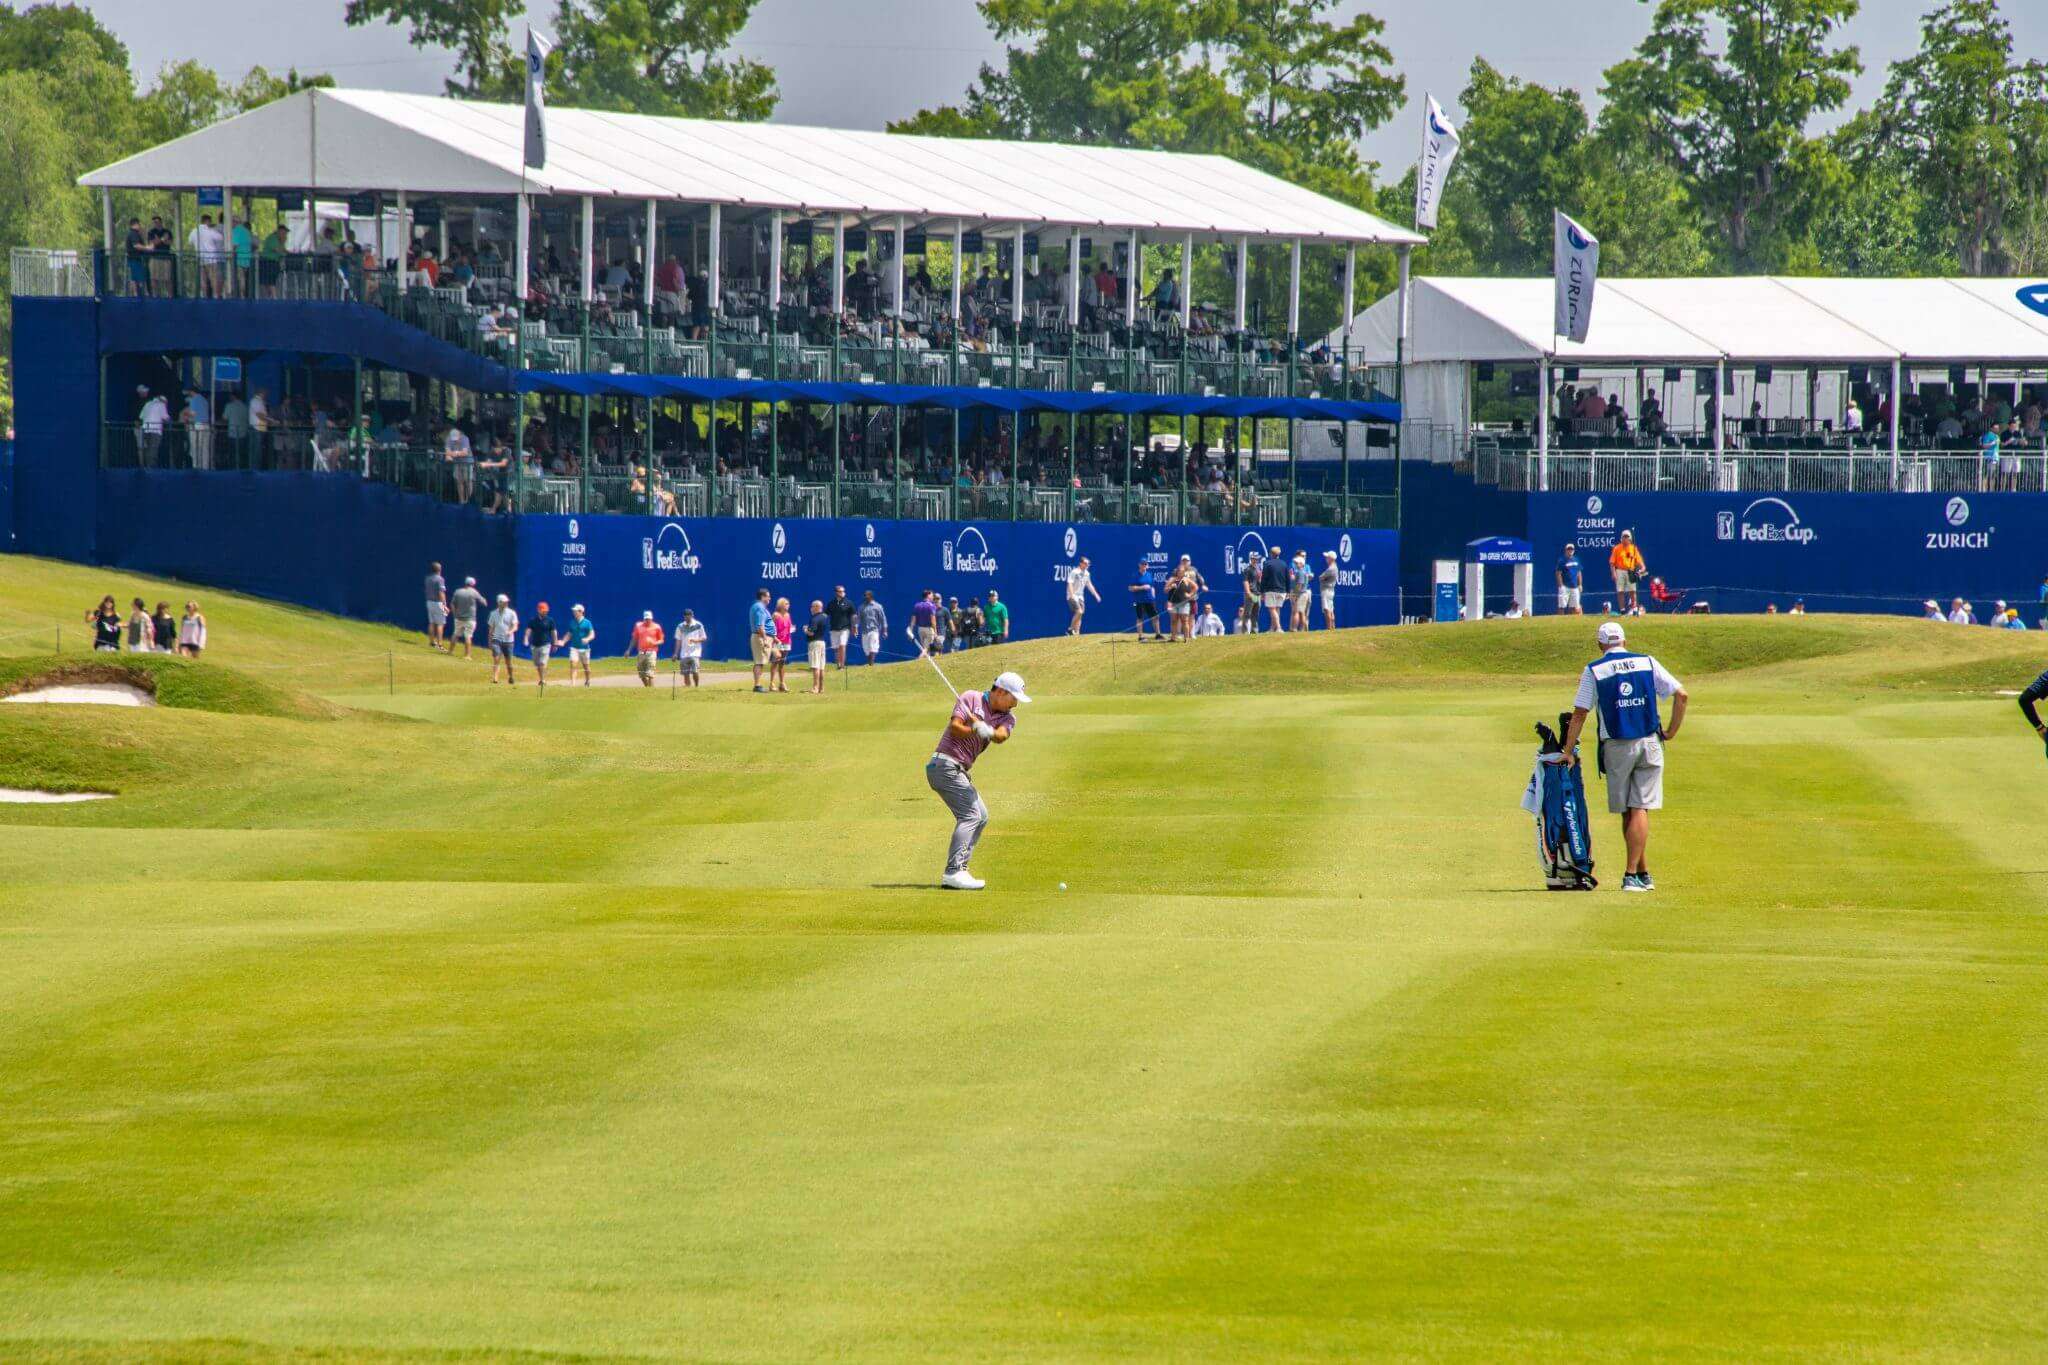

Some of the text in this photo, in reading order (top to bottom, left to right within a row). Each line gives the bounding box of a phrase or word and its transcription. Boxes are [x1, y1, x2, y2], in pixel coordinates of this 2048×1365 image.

[1577, 518, 1615, 529] ZURICH
[1742, 522, 1814, 545] FedExCup
[1577, 537, 1616, 548] CLASSIC
[1926, 532, 1989, 549] ZURICH
[562, 543, 586, 555] ZURICH
[859, 547, 882, 558] ZURICH
[563, 565, 587, 577] CLASSIC
[761, 561, 798, 580] ZURICH
[860, 568, 882, 579] CLASSIC
[1054, 565, 1070, 581] ZUR
[1153, 571, 1169, 582] ASSIC
[1336, 571, 1362, 586] URICH
[1612, 660, 1636, 672] KANG
